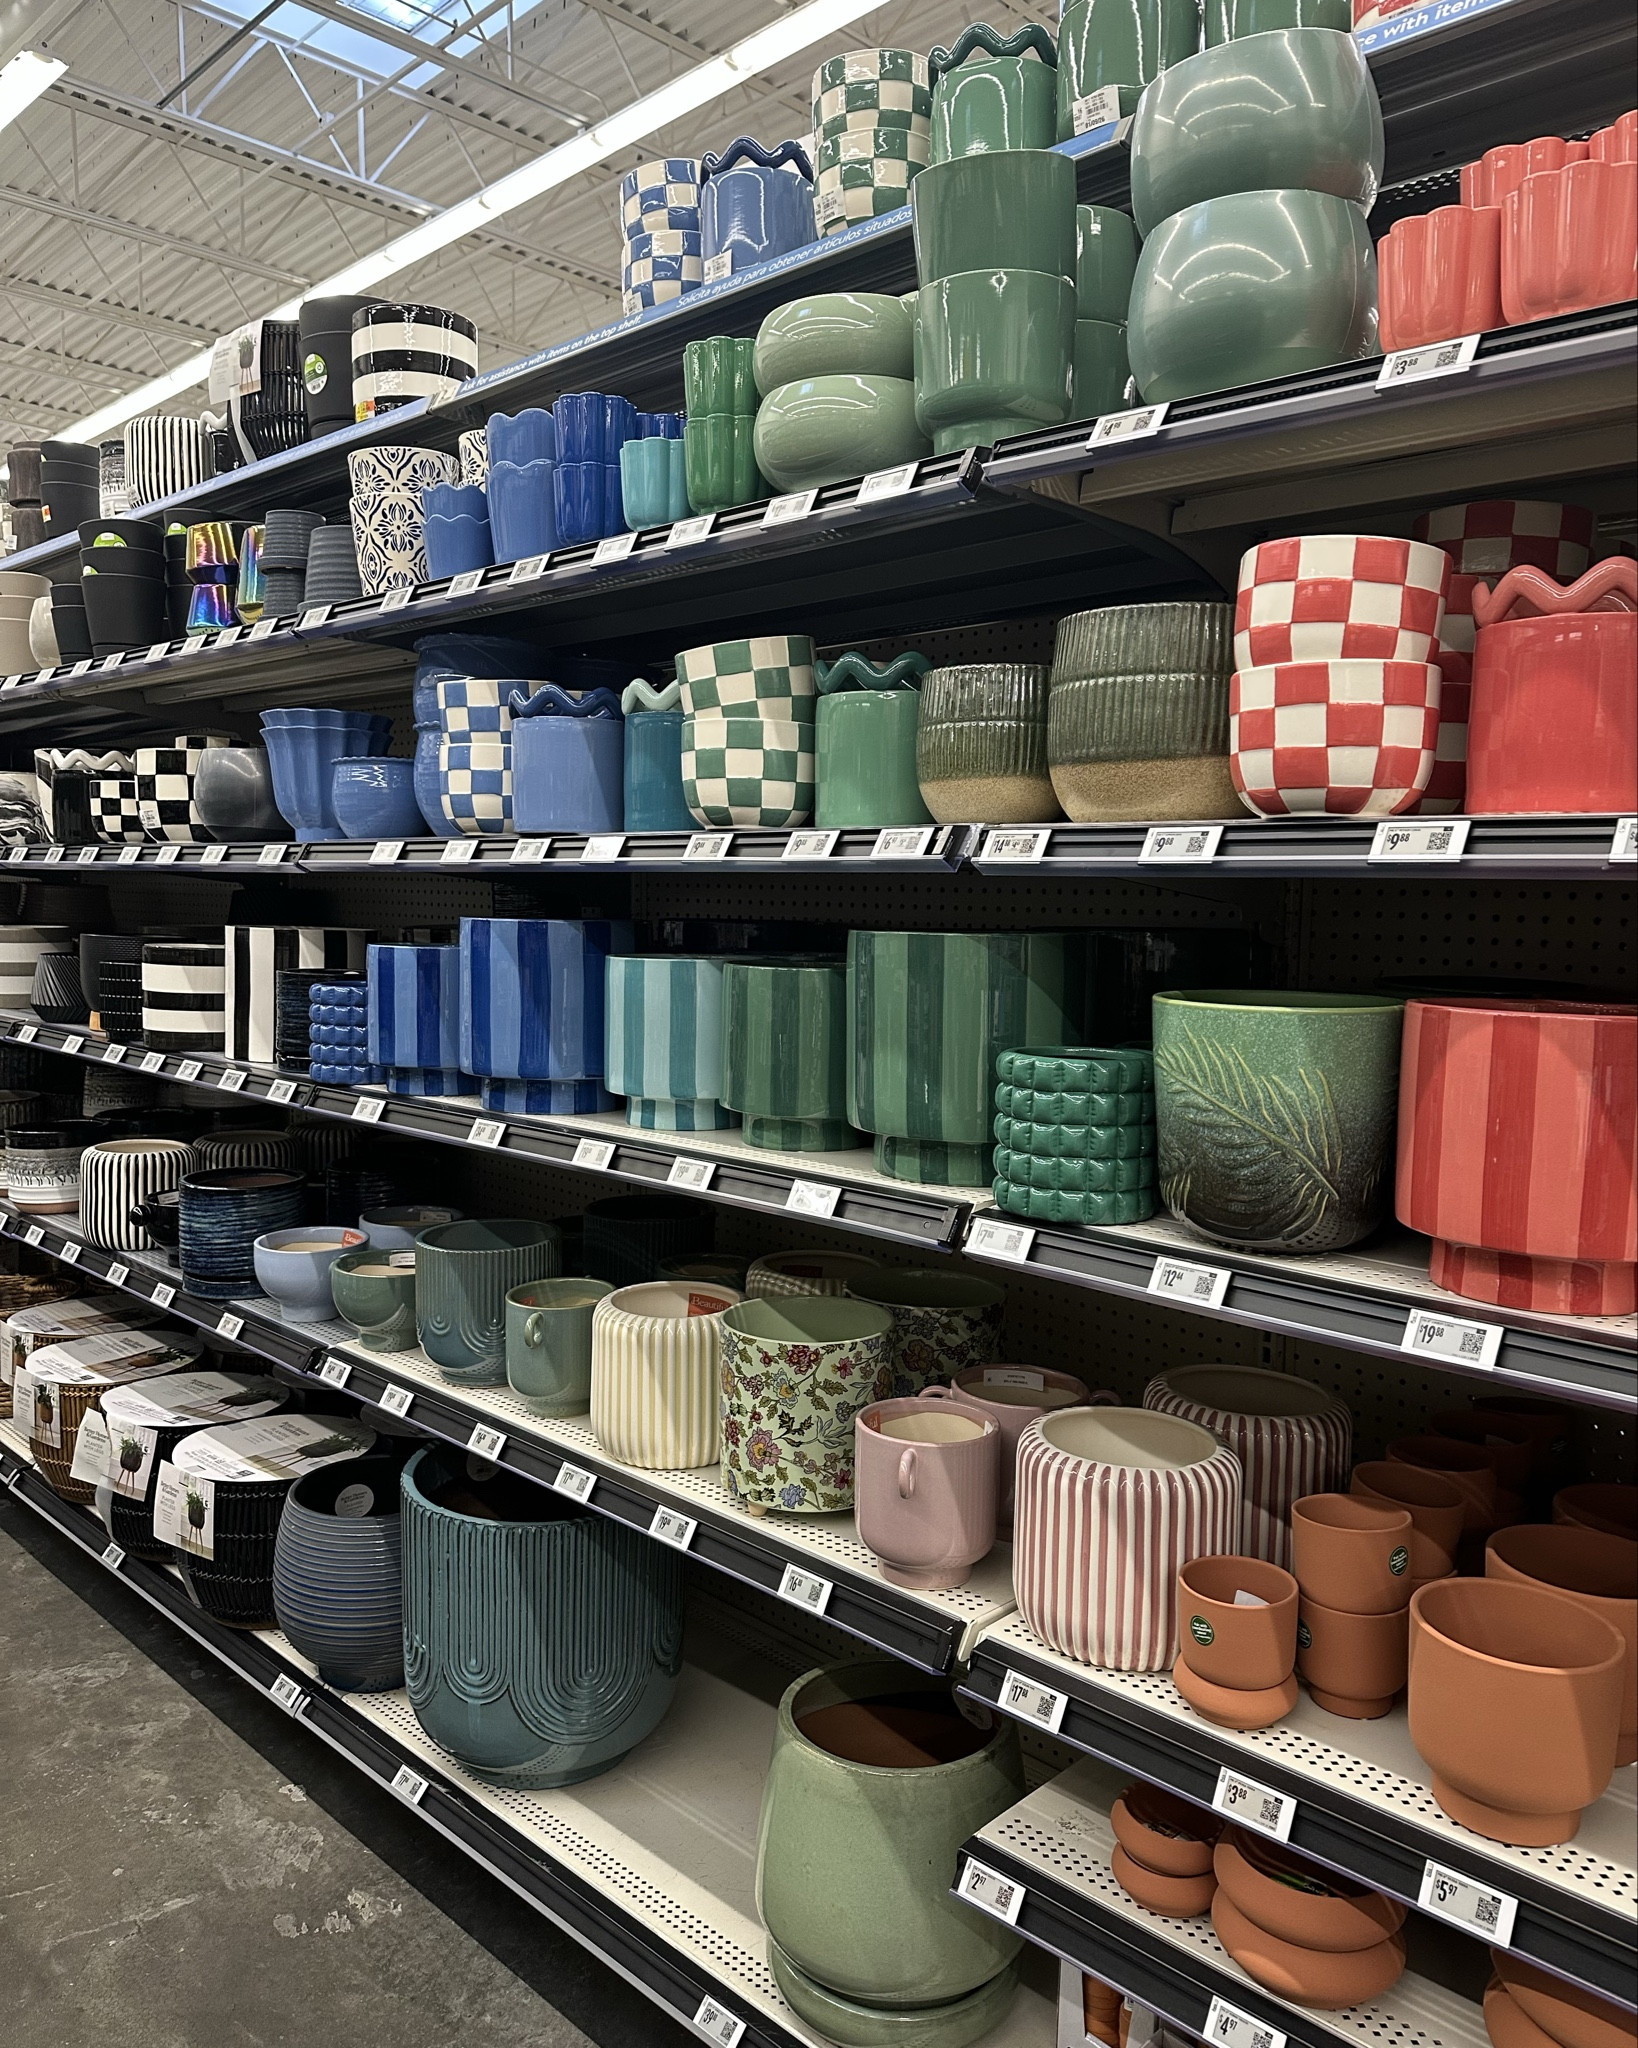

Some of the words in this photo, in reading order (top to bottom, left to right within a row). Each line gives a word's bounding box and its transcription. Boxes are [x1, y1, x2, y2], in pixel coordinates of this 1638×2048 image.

[1383, 12, 1428, 38] with
[1435, 0, 1490, 19] item
[677, 289, 710, 307] Solicita
[711, 276, 741, 294] ayuda
[742, 266, 766, 284] para
[768, 249, 809, 271] obtener
[814, 230, 861, 254] artículos
[863, 209, 912, 234] situados
[462, 379, 476, 391] Ask
[477, 376, 489, 386] for
[489, 362, 528, 381] assistance
[528, 354, 546, 366] with
[547, 346, 570, 359] items
[571, 340, 583, 349] on
[584, 332, 600, 345] the
[601, 327, 616, 339] top
